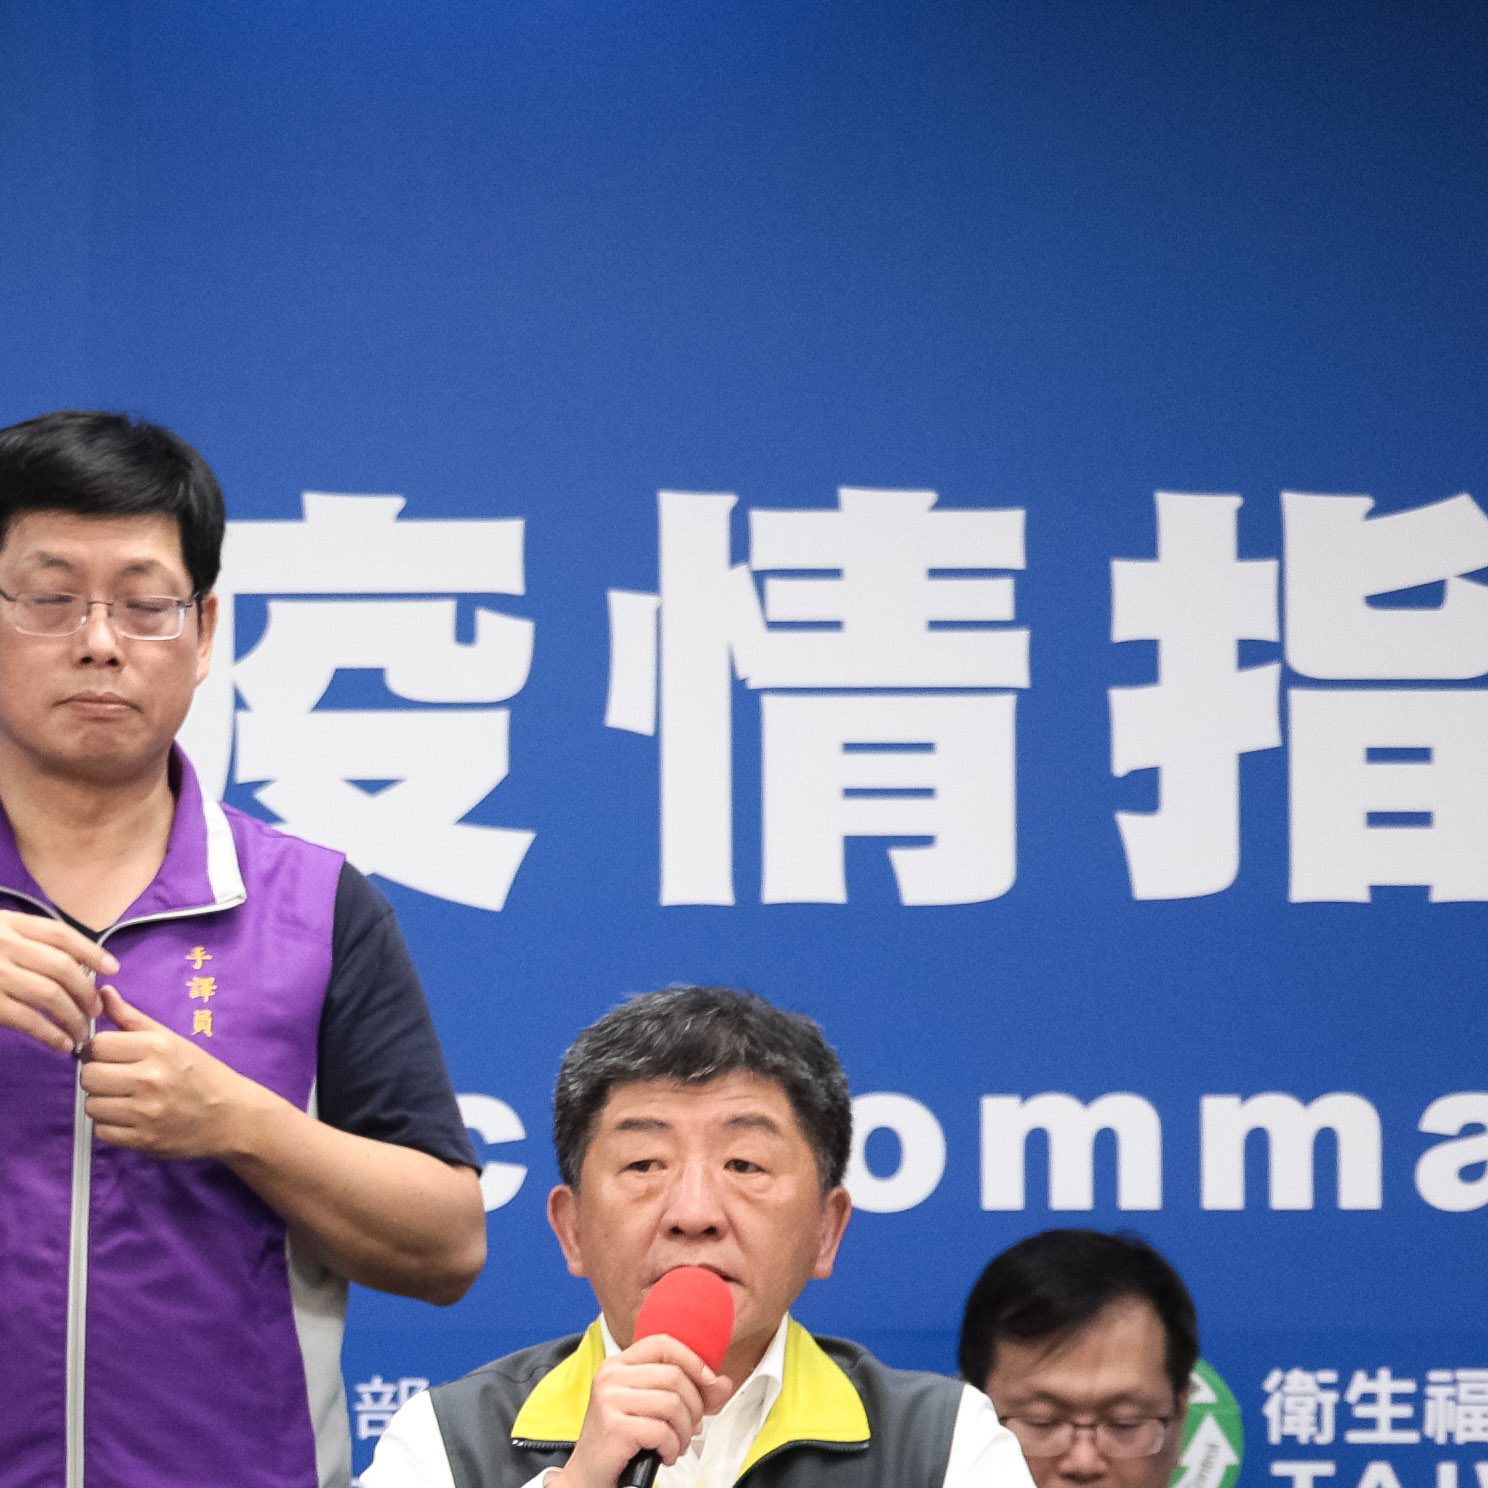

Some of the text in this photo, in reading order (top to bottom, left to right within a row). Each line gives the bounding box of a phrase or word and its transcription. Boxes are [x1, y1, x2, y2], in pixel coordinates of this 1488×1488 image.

[185, 945, 218, 1038] 手譯員
[838, 1092, 1488, 1213] omma
[1261, 1366, 1488, 1446] 衛生福
